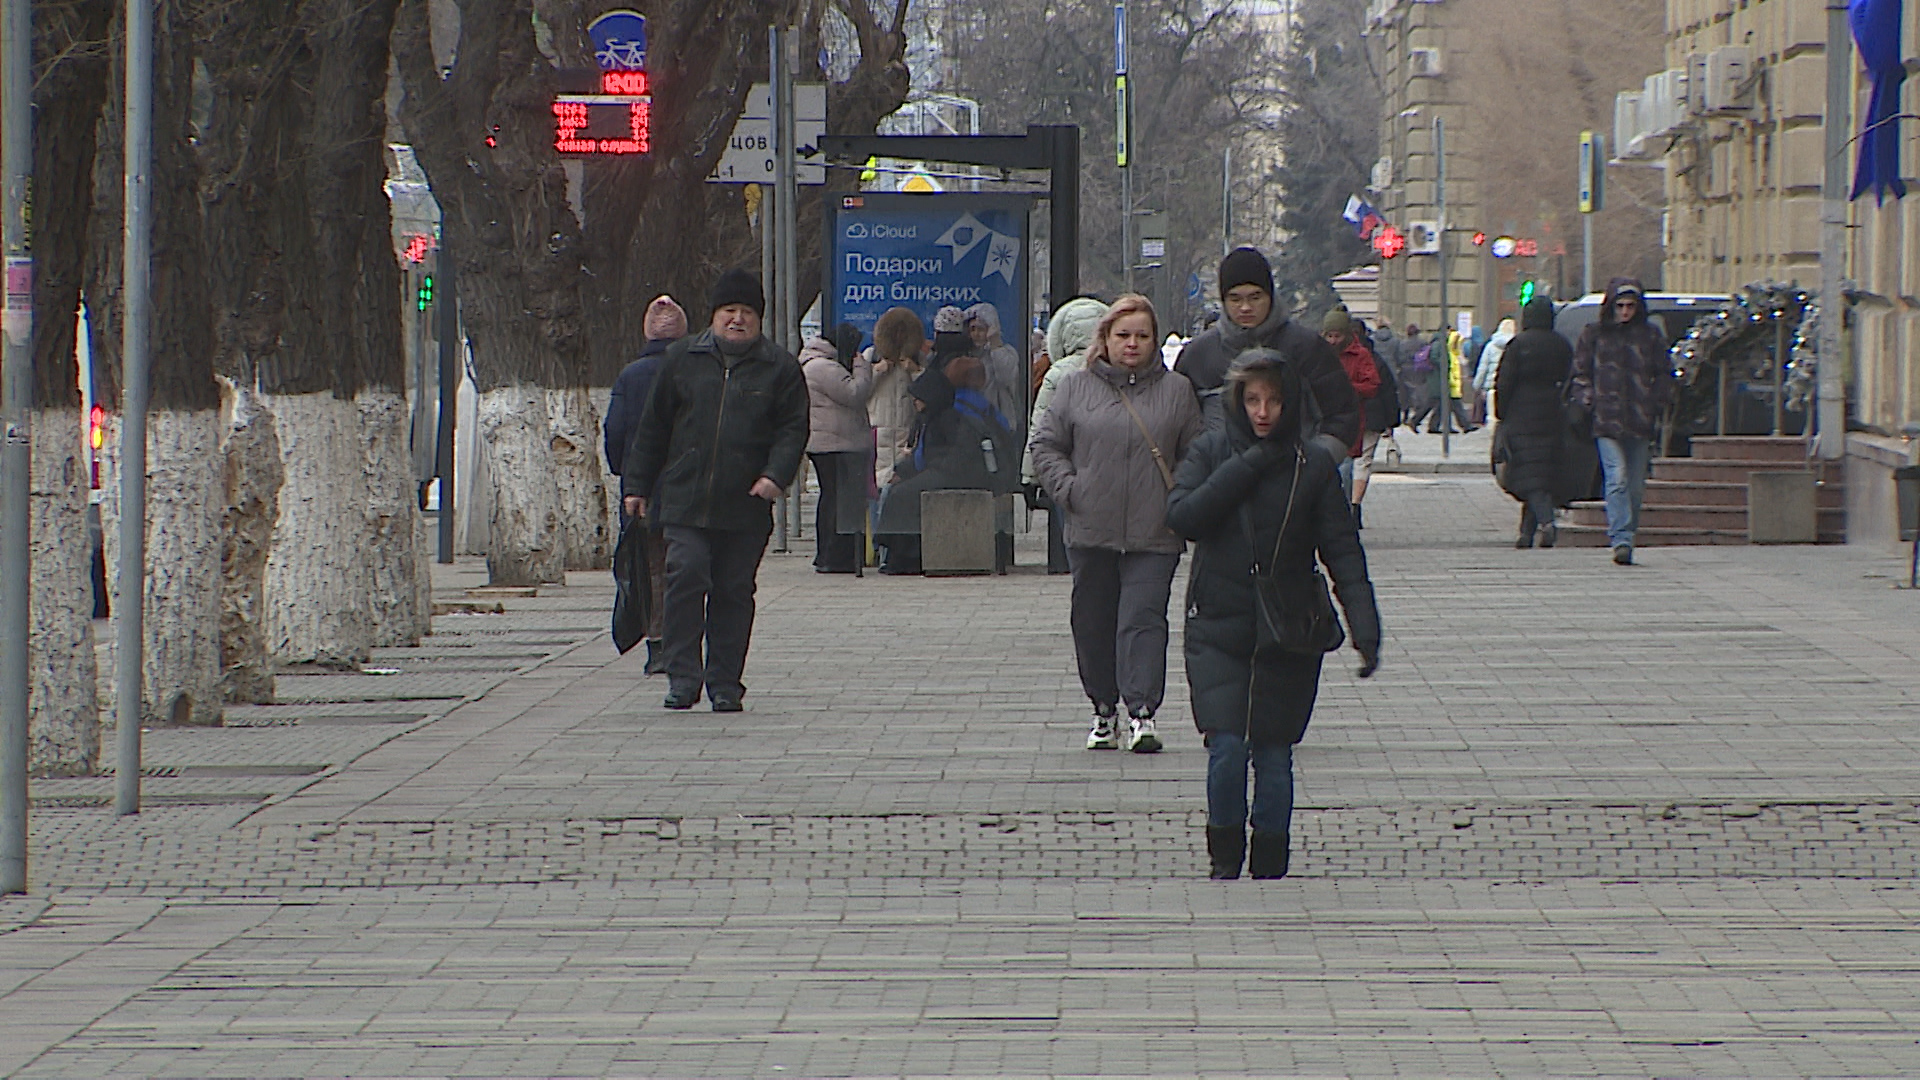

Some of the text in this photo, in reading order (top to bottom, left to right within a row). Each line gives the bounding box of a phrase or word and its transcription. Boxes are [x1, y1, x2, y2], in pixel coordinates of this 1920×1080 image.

[871, 224, 917, 239] iCloud
[845, 253, 942, 278] Подарки
[843, 281, 981, 304] для близких
